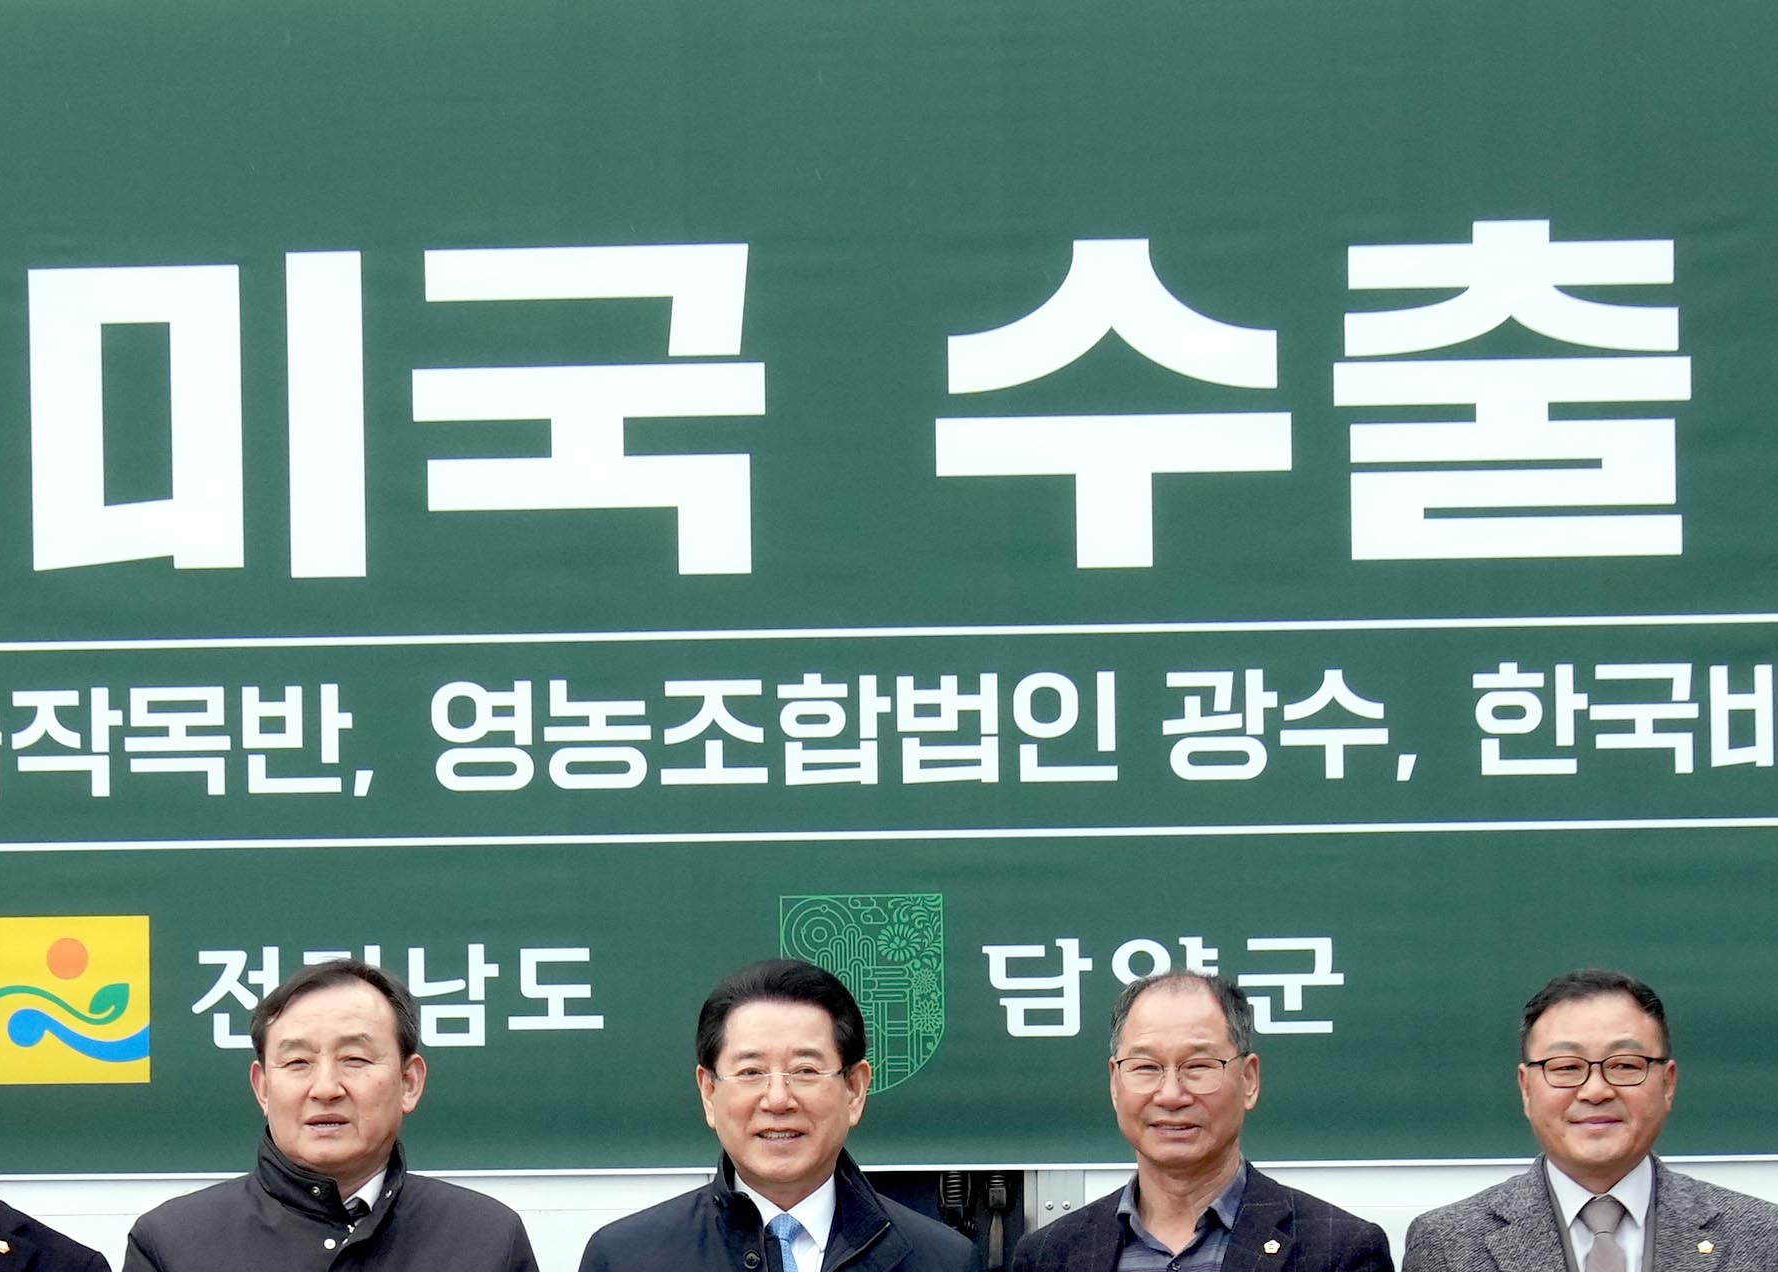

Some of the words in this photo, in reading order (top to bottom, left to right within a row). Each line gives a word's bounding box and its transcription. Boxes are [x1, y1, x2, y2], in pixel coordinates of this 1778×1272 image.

[28, 244, 765, 578] 미국
[935, 220, 1691, 568] 수출
[431, 671, 1118, 791] 영농조합법인
[1163, 669, 1416, 781] 광수,
[192, 944, 604, 1048] 전남도
